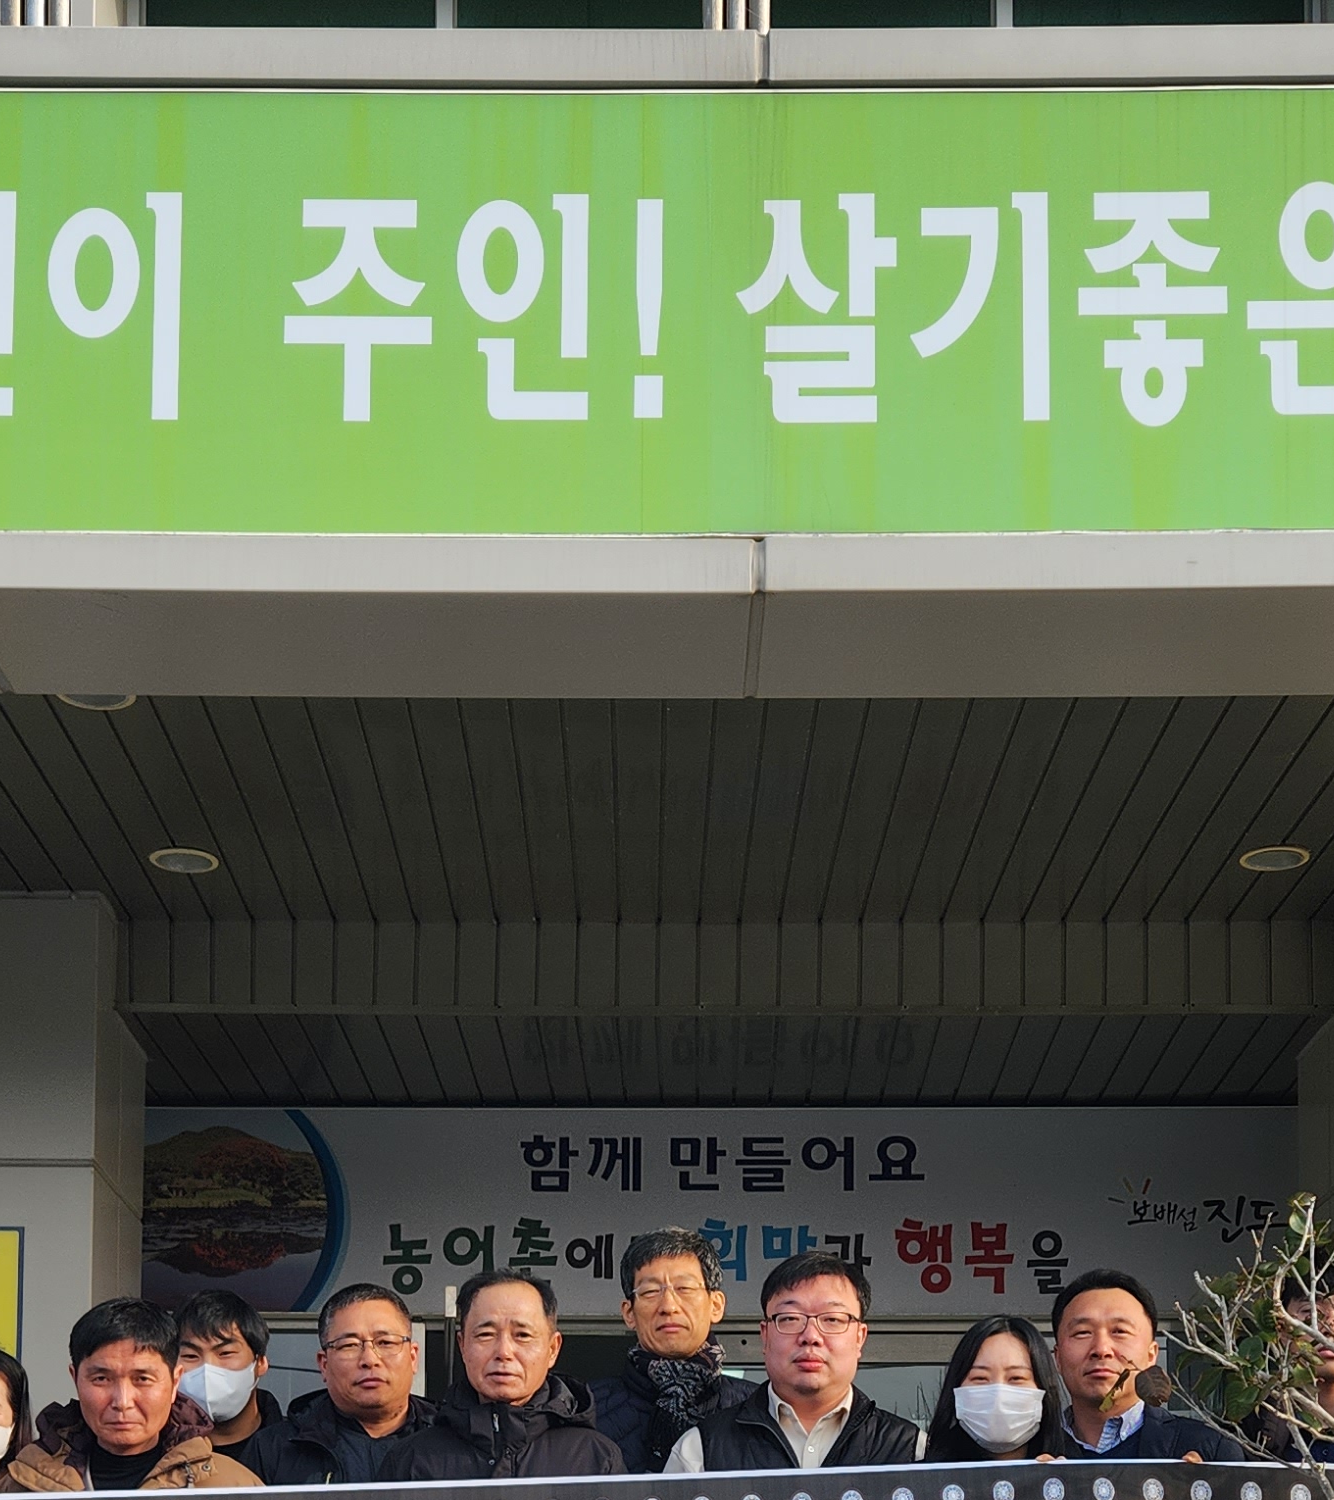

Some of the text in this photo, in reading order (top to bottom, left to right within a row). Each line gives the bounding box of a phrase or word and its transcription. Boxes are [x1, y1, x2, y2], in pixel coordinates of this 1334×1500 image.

[283, 193, 664, 422] 주인!
[519, 1133, 926, 1193] 함께 만들어요
[1127, 1195, 1290, 1244] 보배섬 진도
[382, 1216, 639, 1296] 농어촌에
[894, 1217, 1070, 1295] 행복을
